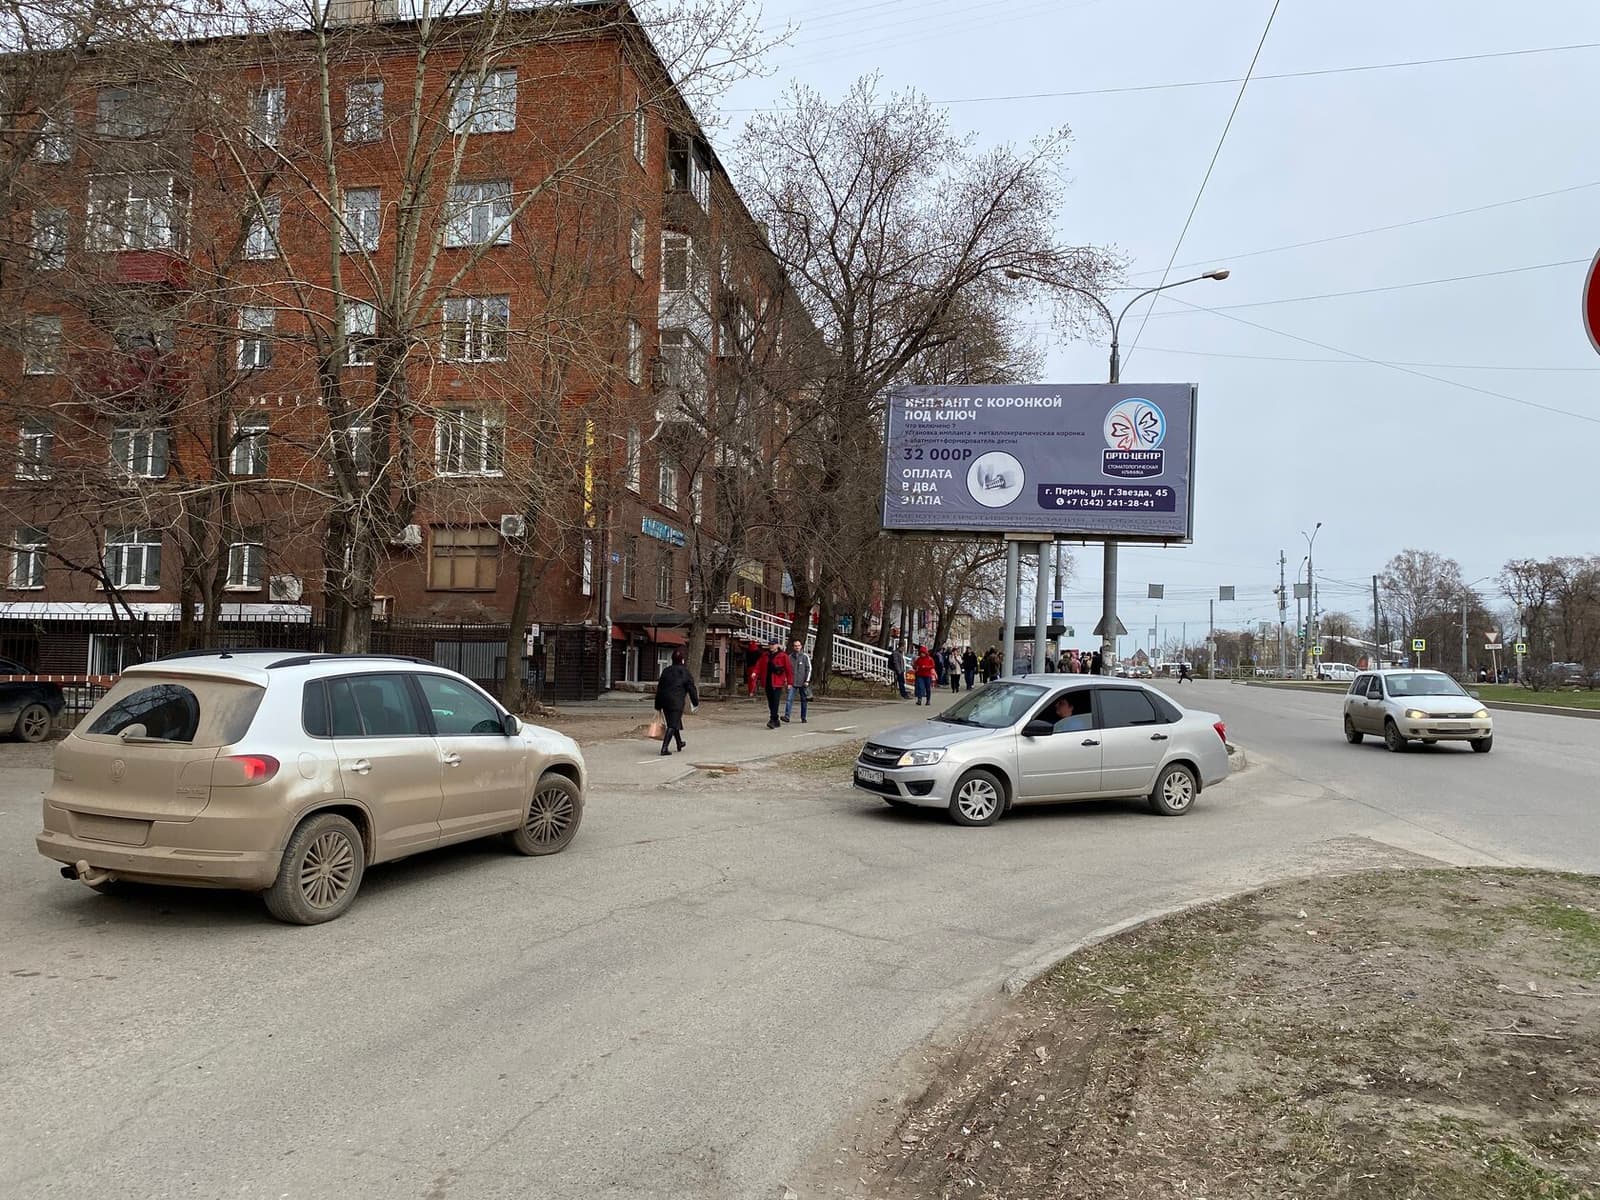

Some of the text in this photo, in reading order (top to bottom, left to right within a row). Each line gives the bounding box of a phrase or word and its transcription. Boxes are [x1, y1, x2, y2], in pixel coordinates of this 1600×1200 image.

[974, 397, 983, 408] С
[987, 394, 1062, 408] КОРОНКОЙ
[904, 410, 977, 422] ПОД КЛЮЧ
[904, 448, 923, 460] 32
[1106, 452, 1161, 460] ОРТО-ЦЕНТР
[903, 469, 953, 479] ОПЛАТА
[912, 482, 938, 493] ДВА
[1055, 488, 1089, 496] Пермь,
[1155, 489, 1169, 497] 45
[1080, 498, 1104, 507] (342)
[1106, 499, 1155, 507] 241-28-41
